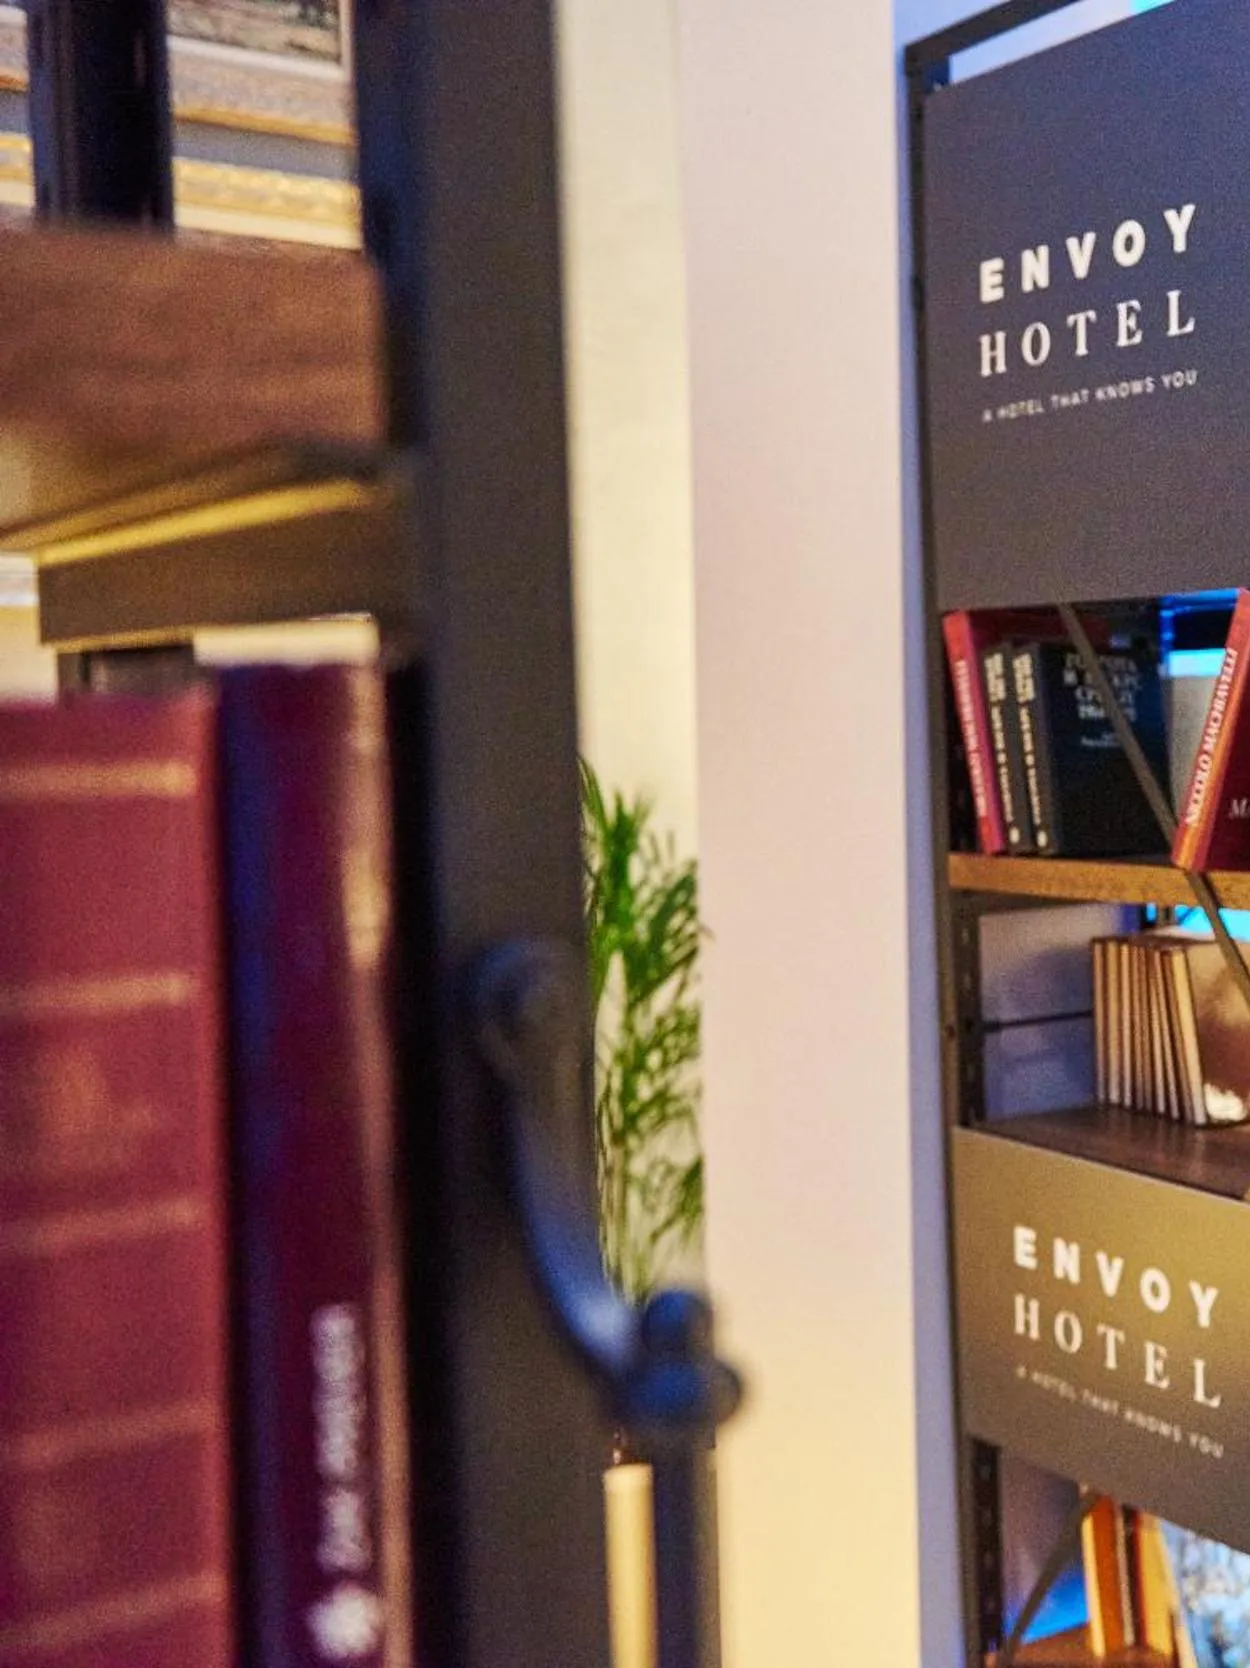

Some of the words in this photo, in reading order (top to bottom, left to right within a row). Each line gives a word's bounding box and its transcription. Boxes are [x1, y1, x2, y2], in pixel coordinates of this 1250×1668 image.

[979, 203, 1196, 303] ENVOY
[979, 289, 1196, 378] HOTEL
[1051, 388, 1090, 409] THAT
[1095, 376, 1155, 400] KNOWS
[1161, 369, 1198, 389] YOU
[1013, 1225, 1219, 1329] ENVOY
[1014, 1294, 1221, 1408] HOTEL
